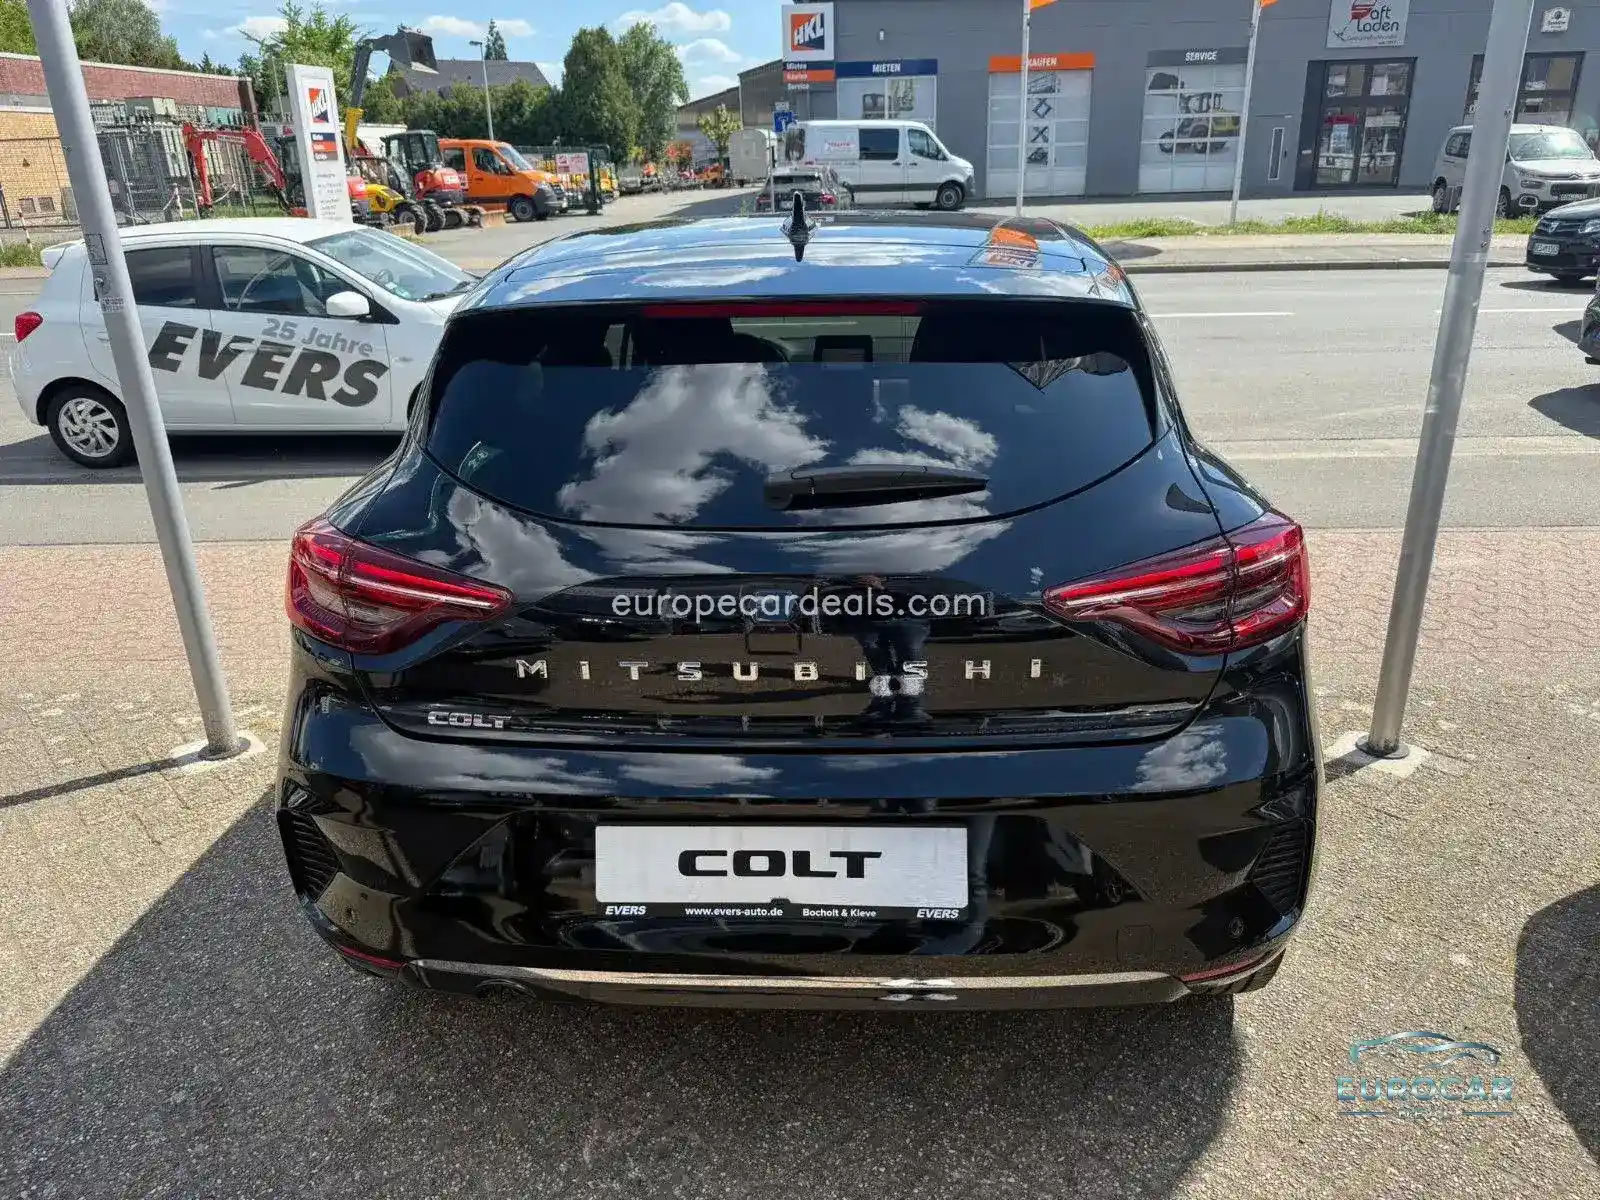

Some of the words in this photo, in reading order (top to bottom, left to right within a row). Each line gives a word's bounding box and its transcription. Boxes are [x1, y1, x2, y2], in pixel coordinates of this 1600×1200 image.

[793, 13, 825, 46] HKL
[1185, 51, 1218, 62] SERVICE
[872, 63, 901, 73] MIETEN
[261, 318, 298, 341] 25
[302, 326, 373, 357] Jahre
[148, 320, 389, 407] EVERS
[515, 659, 1042, 682] MITSUBISHI
[427, 711, 511, 729] COLT
[678, 849, 882, 879] COLT
[605, 905, 647, 916] EVERS
[685, 907, 784, 917] www.evers-auto.de
[802, 908, 839, 918] Bocholt
[841, 908, 848, 917] &
[850, 908, 877, 918] Kleve
[917, 908, 960, 919] EVERS
